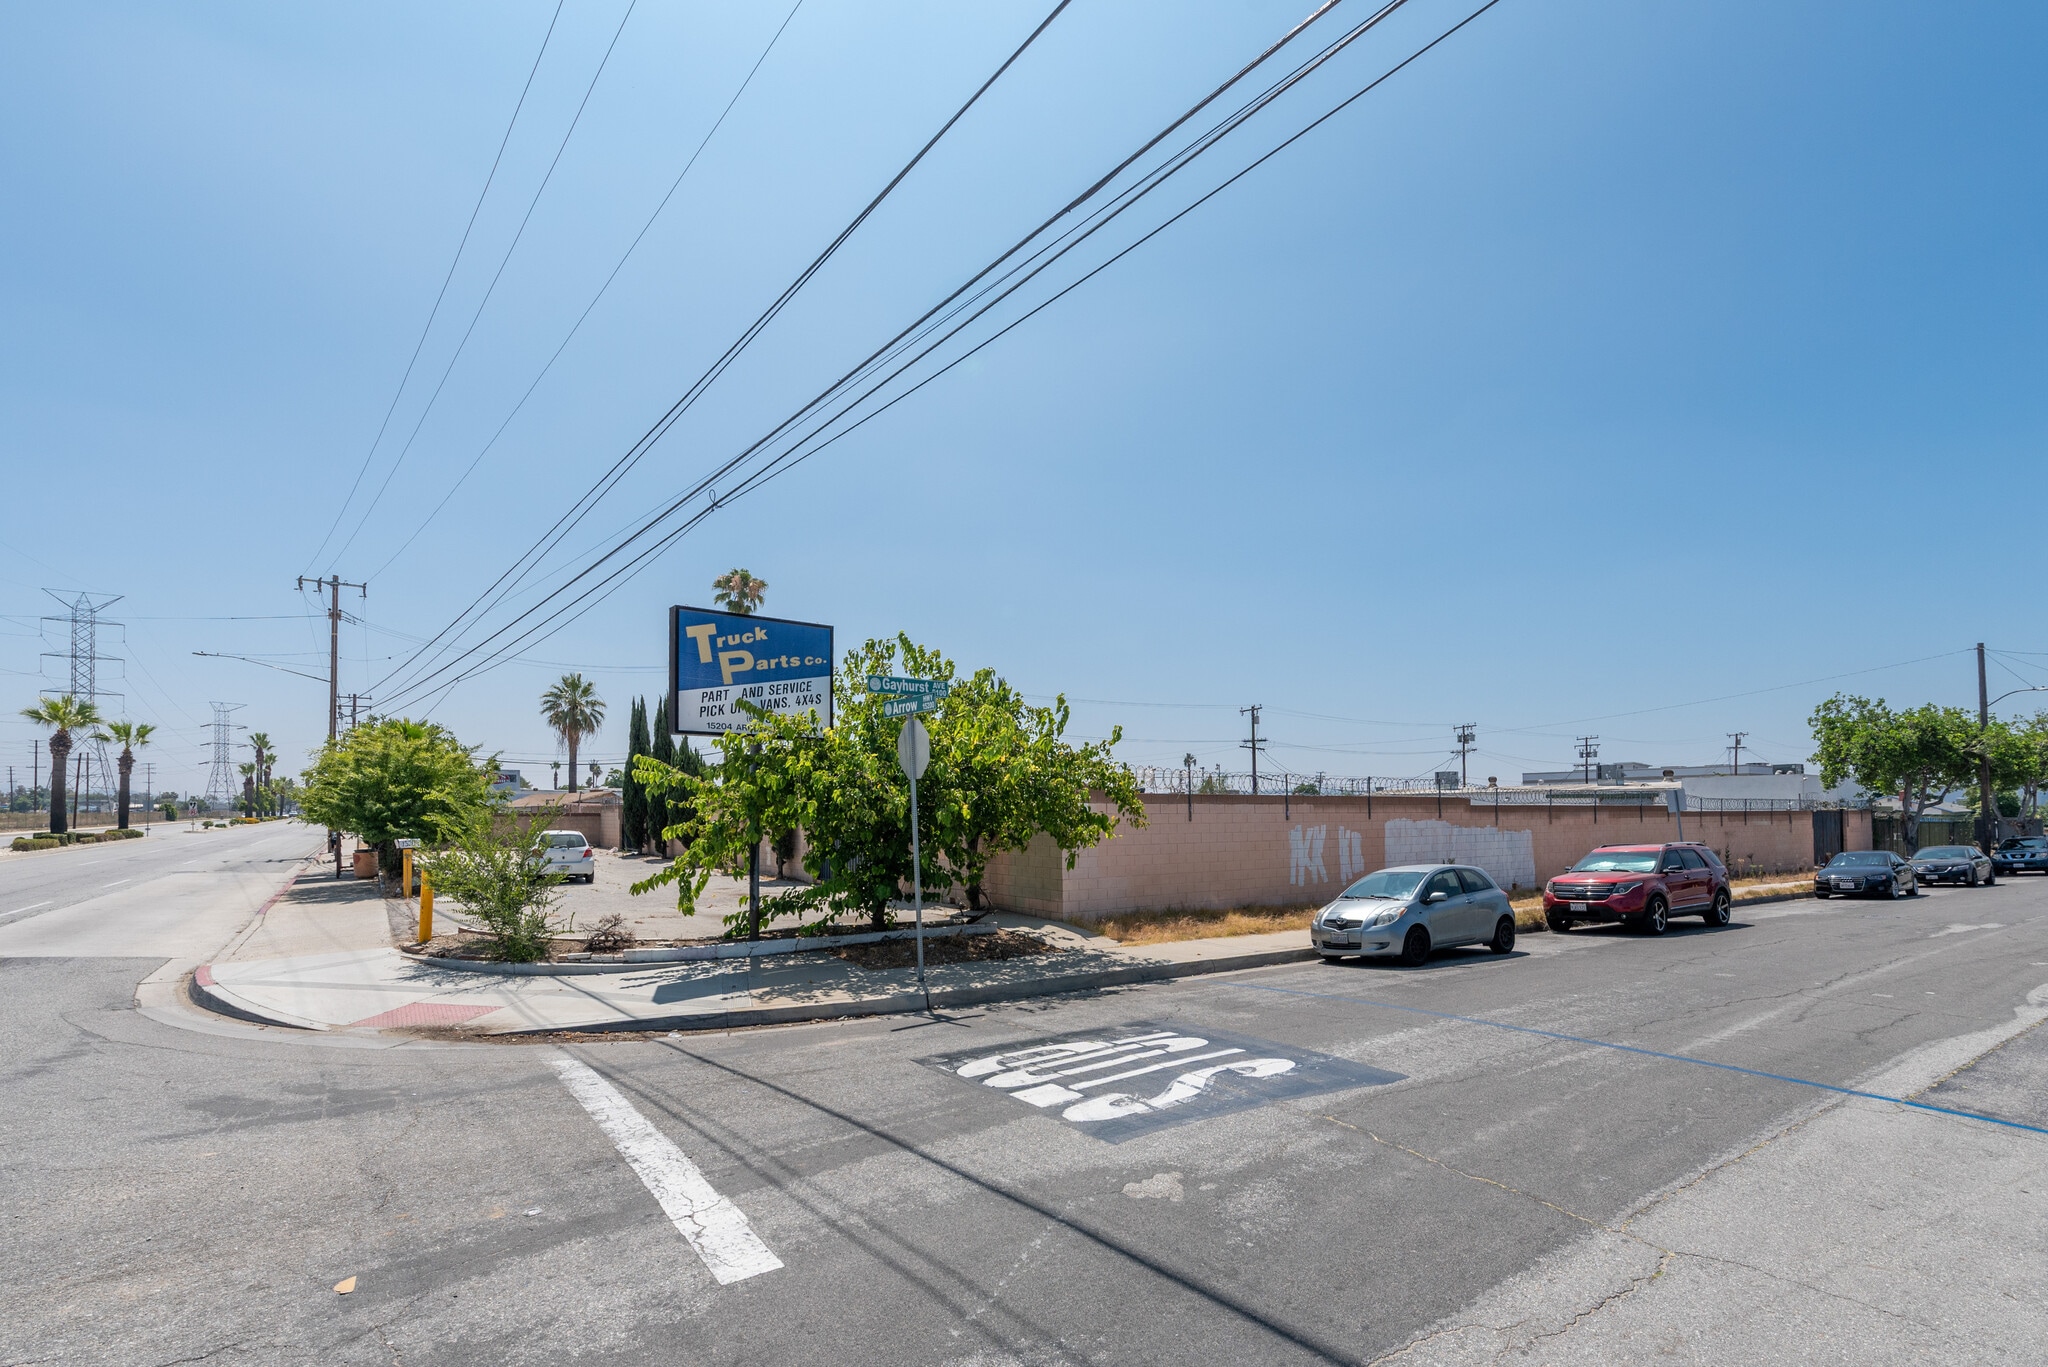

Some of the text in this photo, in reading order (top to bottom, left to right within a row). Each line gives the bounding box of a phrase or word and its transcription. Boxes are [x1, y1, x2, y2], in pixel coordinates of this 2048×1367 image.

[686, 623, 768, 664] Truck
[718, 650, 800, 685] Parts
[701, 680, 812, 704] PART AND SERVICE
[882, 677, 929, 694] Gayhurst
[699, 704, 725, 718] PICK
[795, 693, 822, 706] 4X4S
[892, 701, 918, 715] Arrow
[706, 722, 732, 730] 15204
